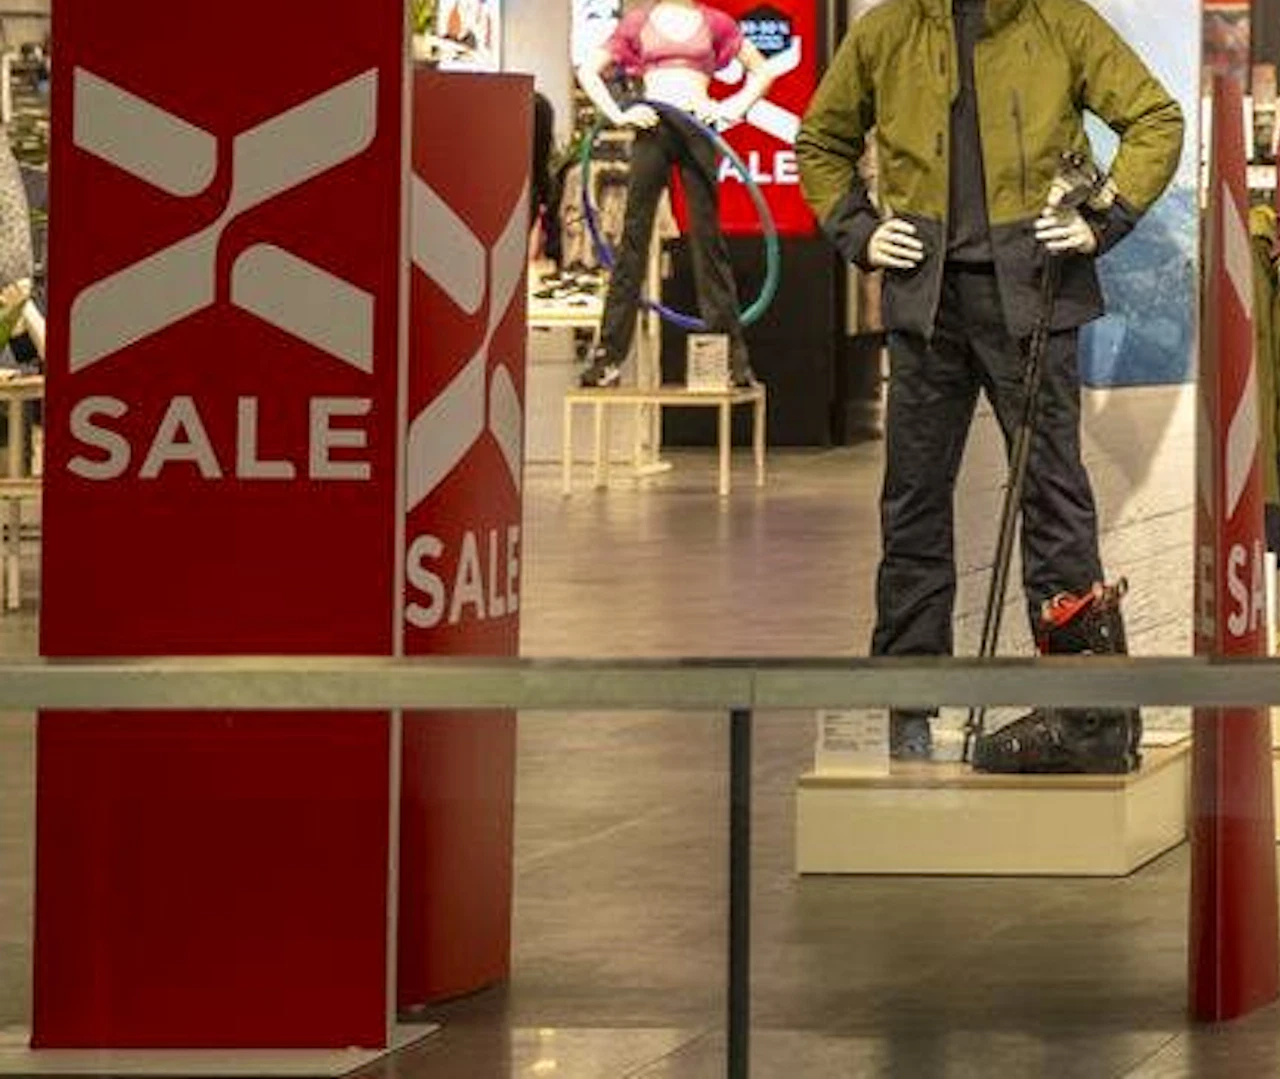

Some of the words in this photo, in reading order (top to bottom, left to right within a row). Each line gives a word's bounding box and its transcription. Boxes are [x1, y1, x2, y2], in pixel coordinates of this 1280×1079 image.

[717, 150, 800, 184] ALE
[66, 395, 373, 481] SALE
[406, 526, 520, 629] SALE
